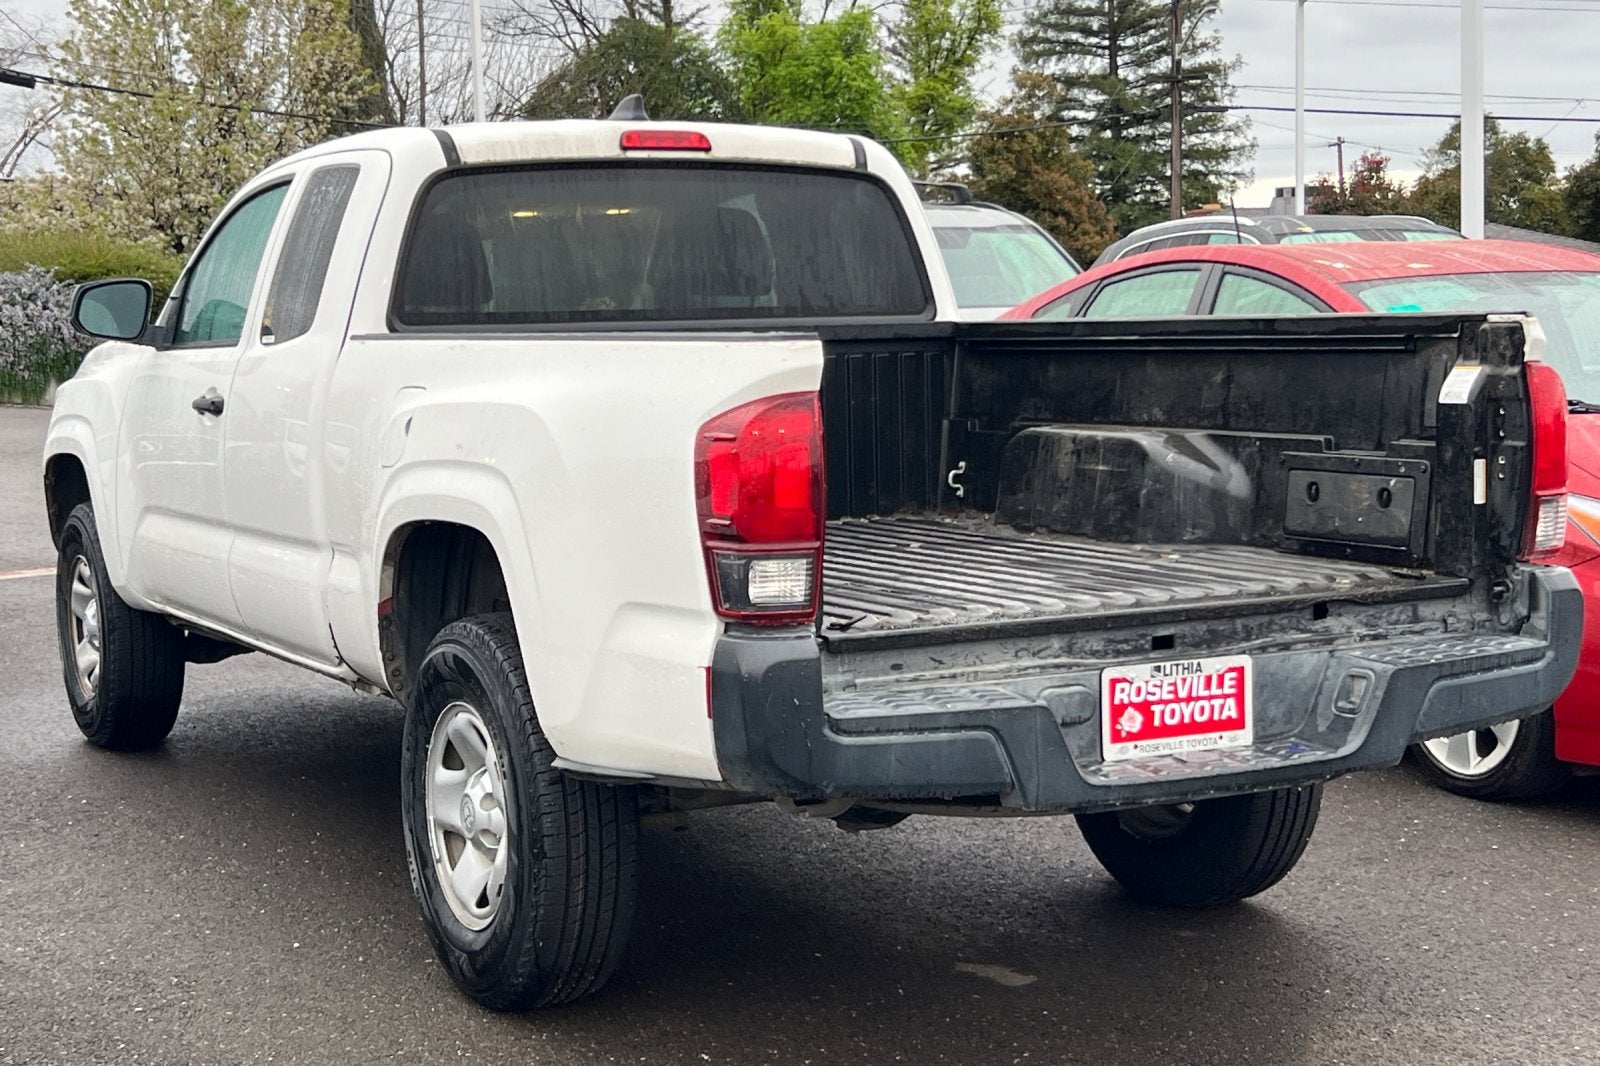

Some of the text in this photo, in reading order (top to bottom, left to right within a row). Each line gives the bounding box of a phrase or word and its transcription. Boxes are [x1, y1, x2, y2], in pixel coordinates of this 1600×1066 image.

[1163, 661, 1203, 677] LITHIA
[1114, 672, 1237, 705] ROSEVILLE
[1151, 697, 1238, 727] TOYOTA
[1139, 736, 1218, 753] ROSEVILLE TOYOTA
